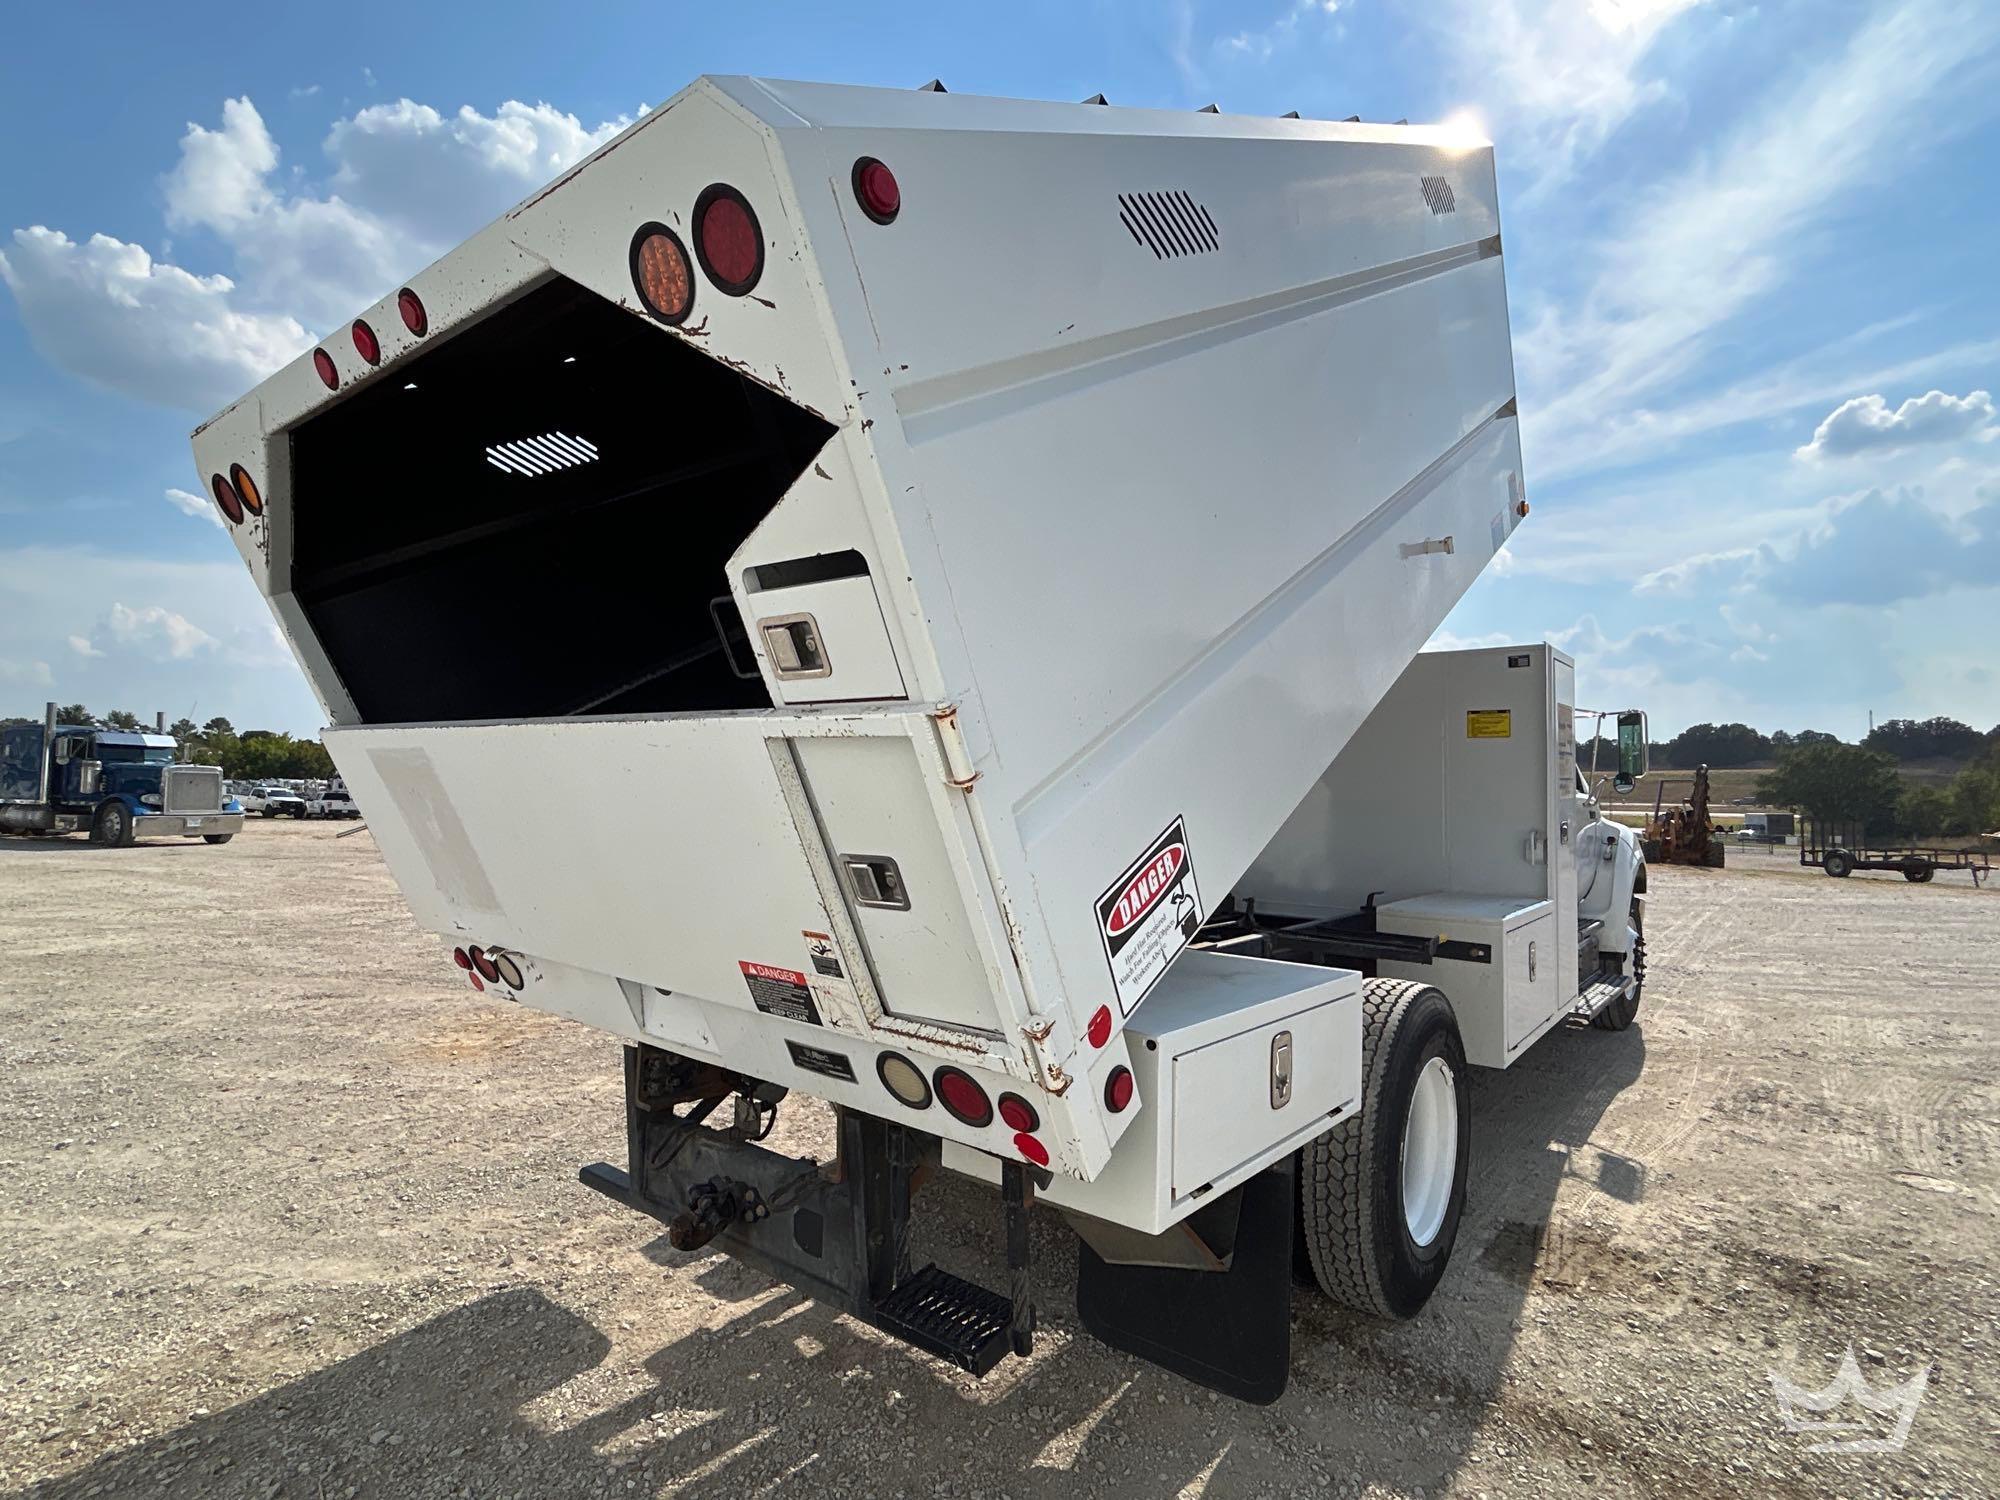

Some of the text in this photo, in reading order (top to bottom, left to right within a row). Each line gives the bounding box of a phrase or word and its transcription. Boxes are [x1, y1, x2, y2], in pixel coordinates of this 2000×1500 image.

[1119, 851, 1174, 925] DANGER
[1124, 912, 1167, 967] Hard Hat Required
[757, 966, 798, 982] DANGER
[1118, 964, 1134, 988] Watch
[1133, 955, 1142, 970] For
[1141, 935, 1159, 961] Falling
[1132, 958, 1152, 987] Workers
[769, 1006, 809, 1022] KEEP CLEAR
